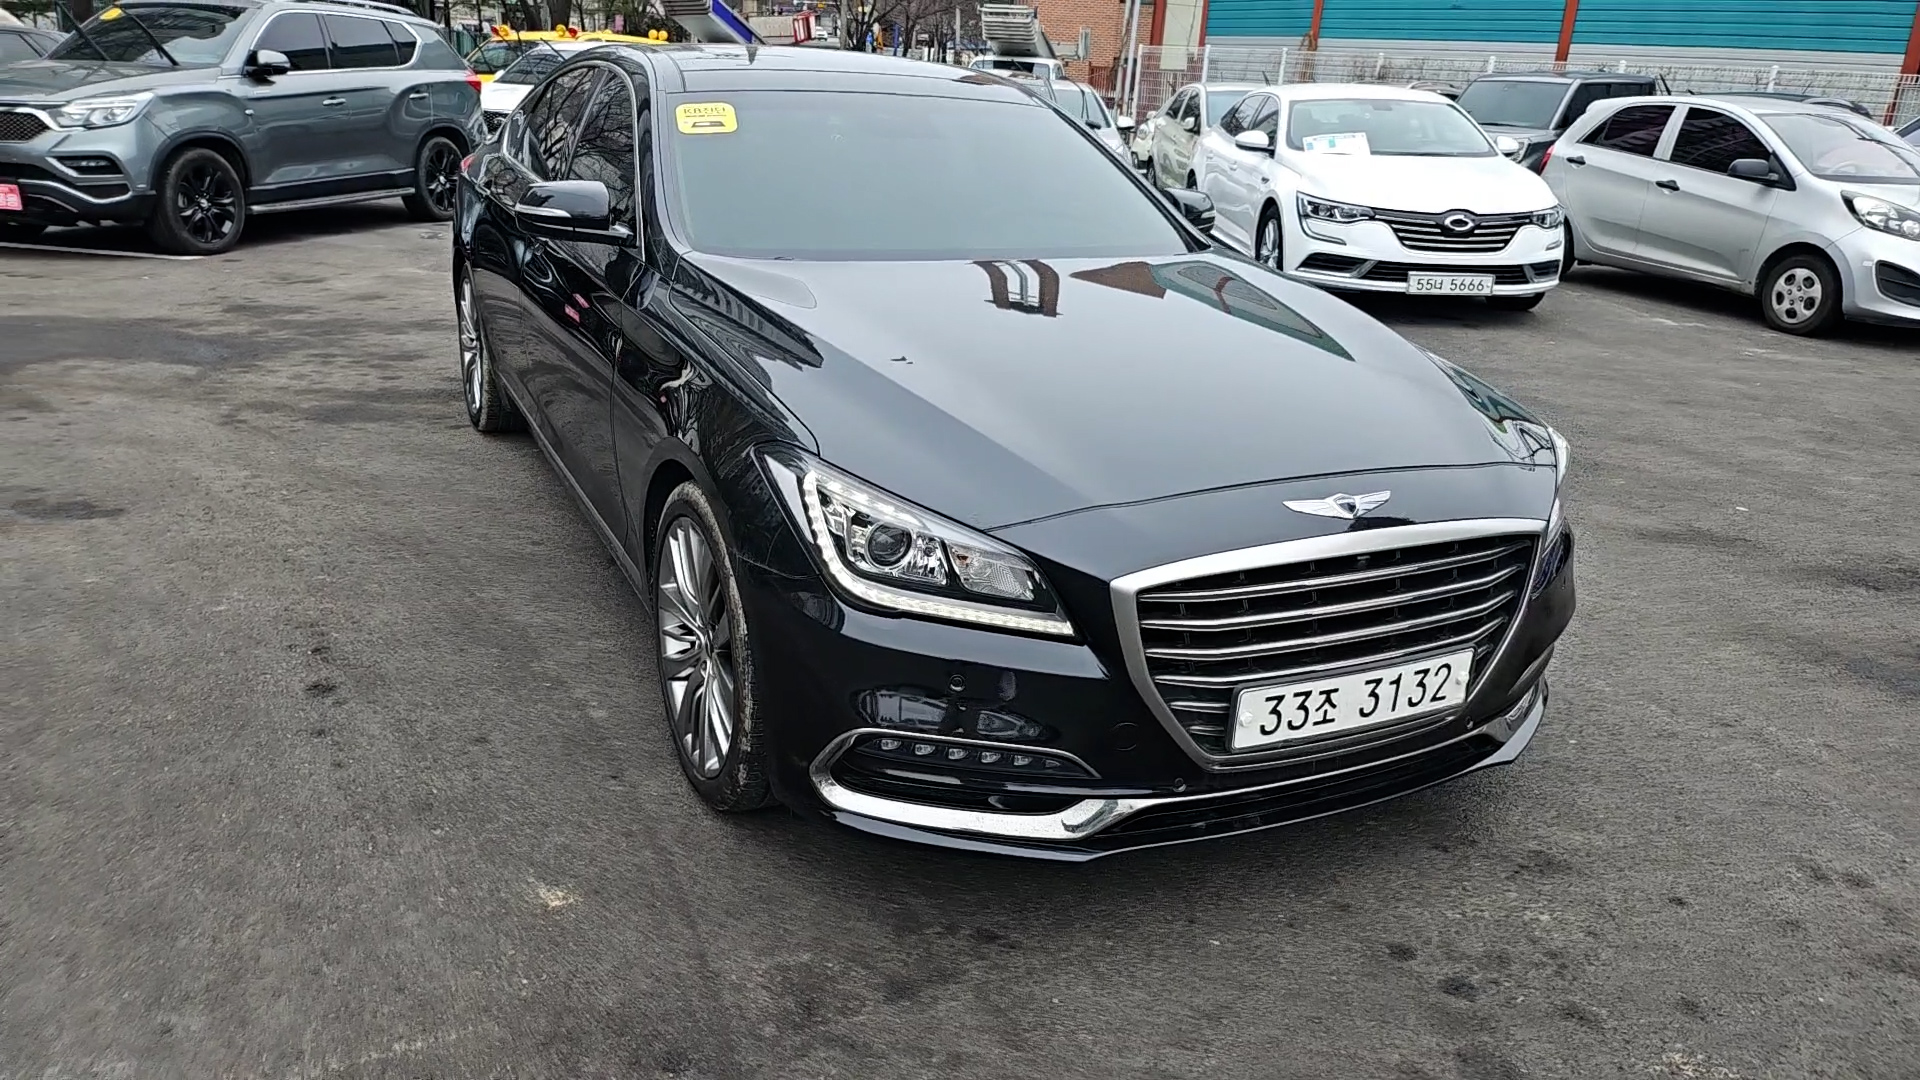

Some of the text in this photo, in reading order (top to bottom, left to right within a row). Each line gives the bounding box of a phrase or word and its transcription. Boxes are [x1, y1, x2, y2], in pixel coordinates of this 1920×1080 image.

[1416, 278, 1485, 292] 55너 5666
[1259, 662, 1452, 736] 33조 3132
